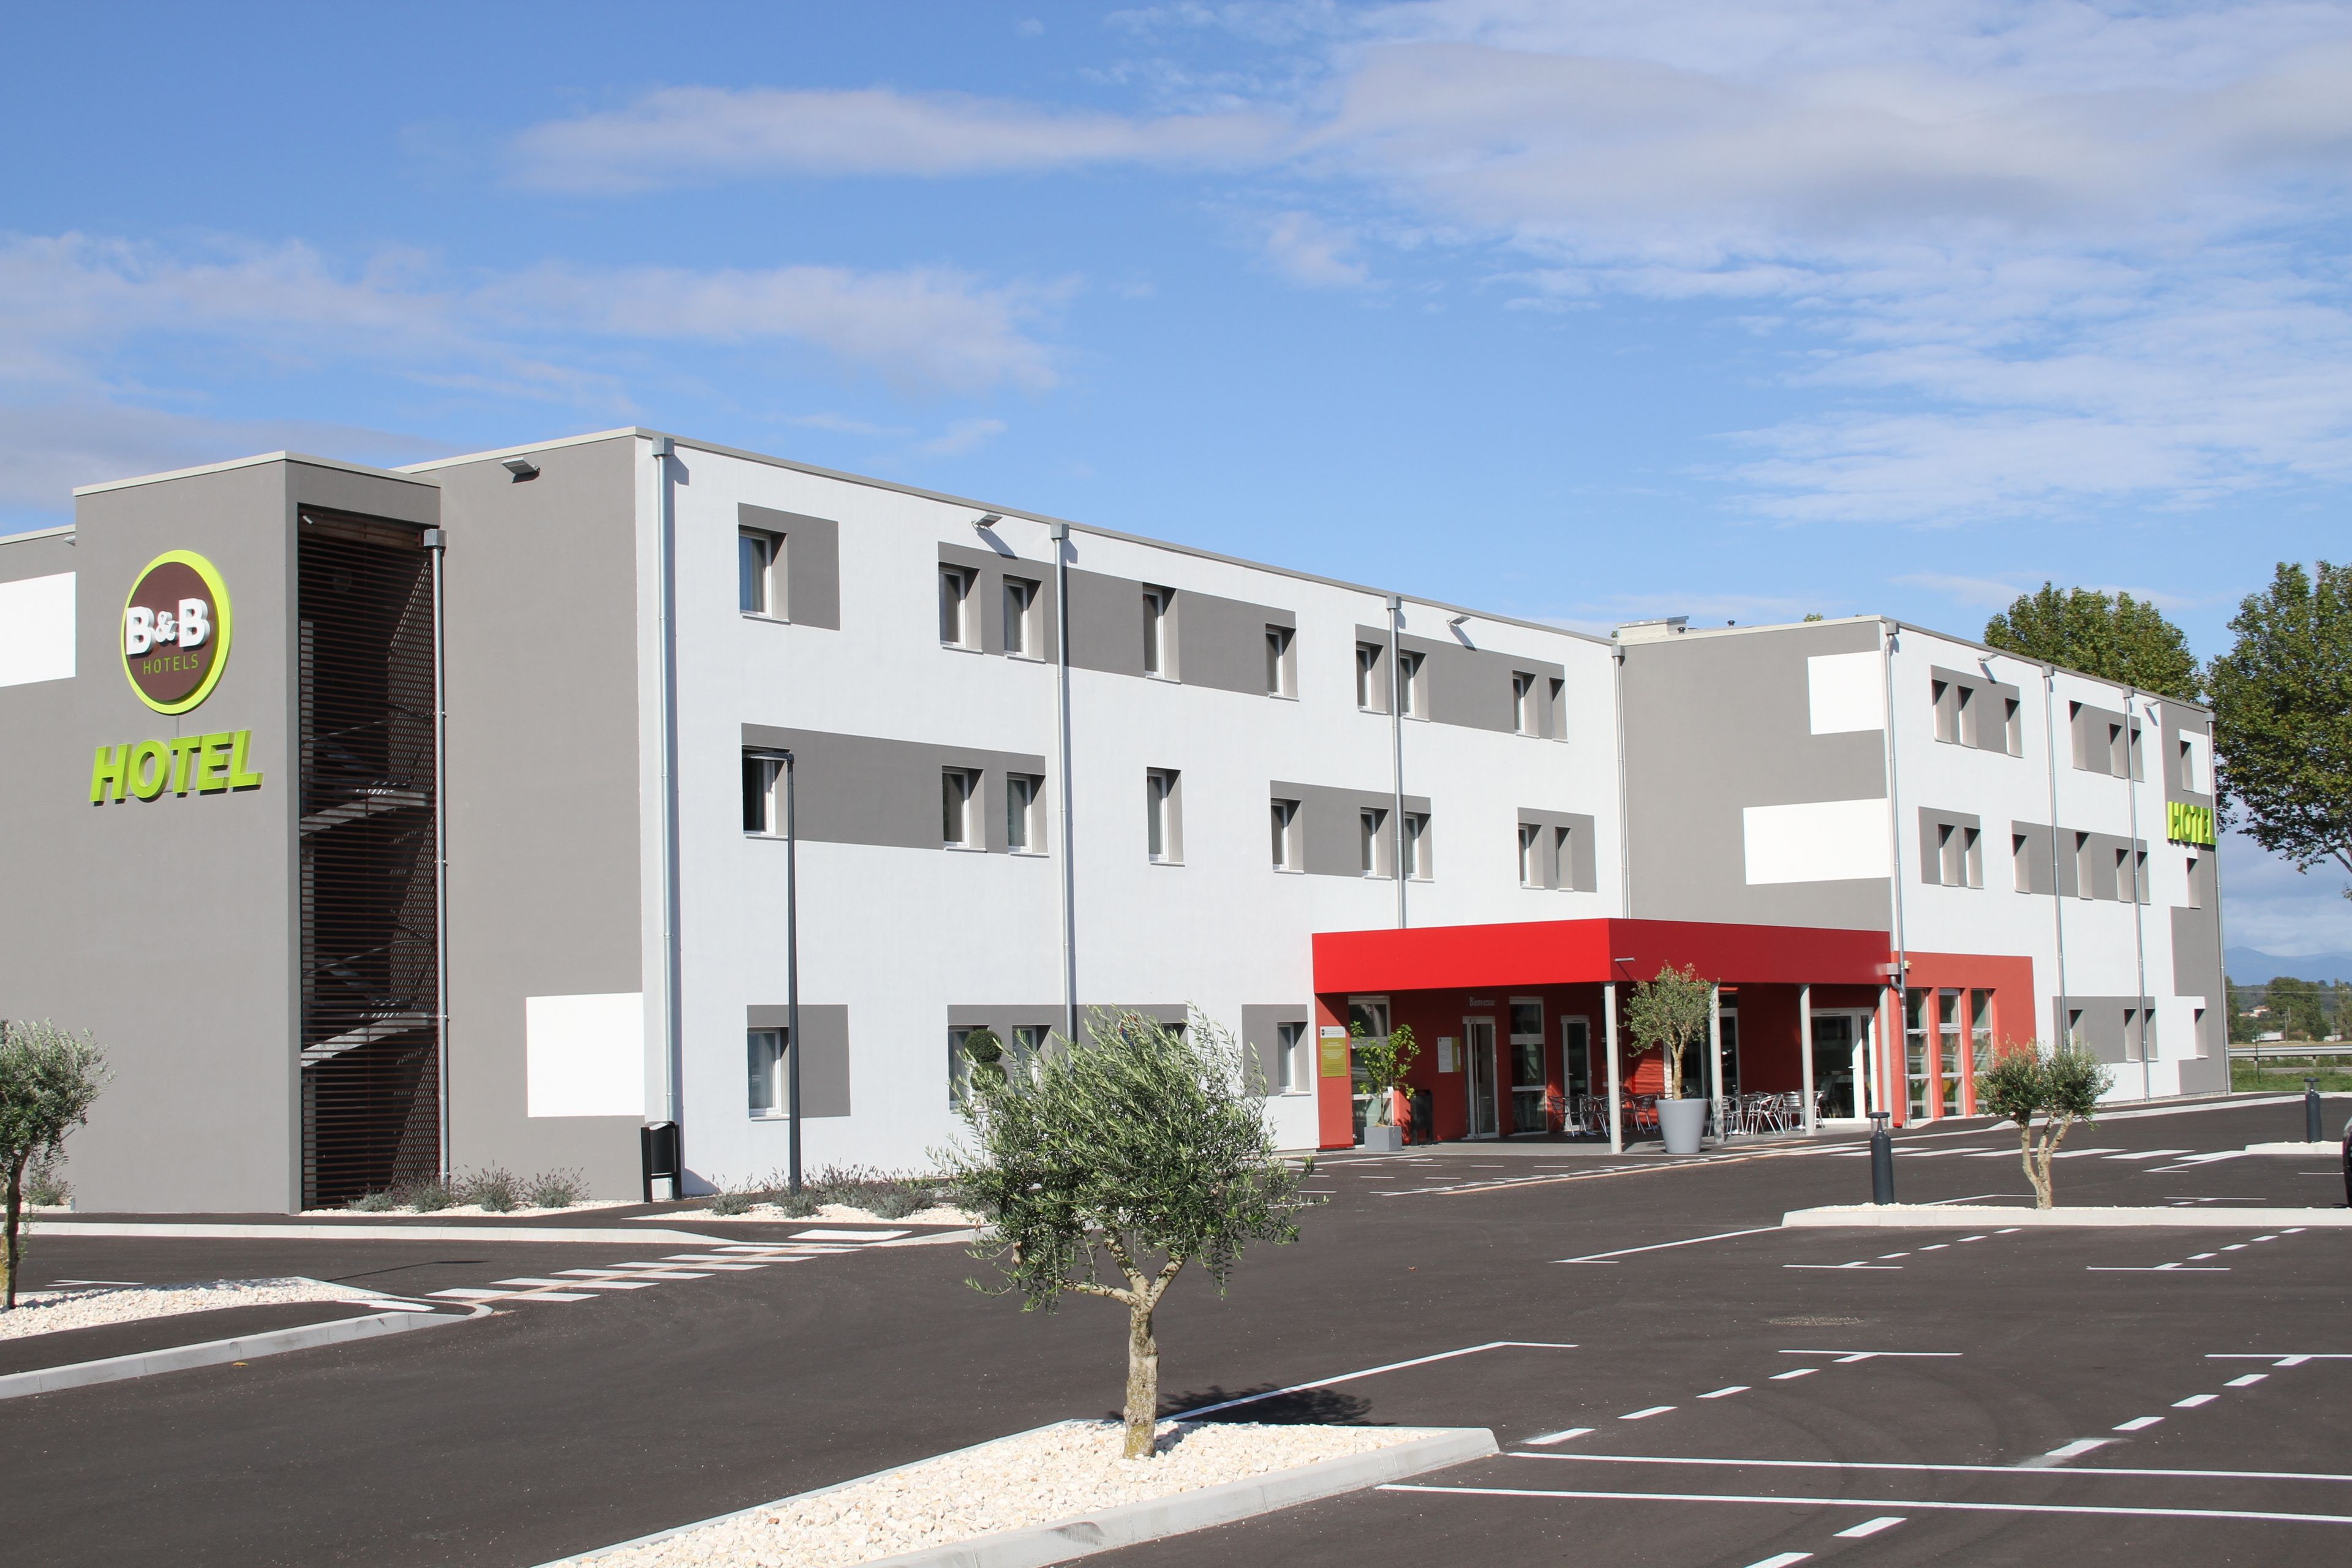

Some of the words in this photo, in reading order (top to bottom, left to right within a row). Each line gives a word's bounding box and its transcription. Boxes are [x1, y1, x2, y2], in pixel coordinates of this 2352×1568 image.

[126, 598, 211, 655] B&B
[143, 654, 198, 675] HOTELS
[89, 729, 264, 802] HOTEL
[2168, 801, 2217, 845] HOTEL
[1469, 997, 1495, 1006] Bienvenue
